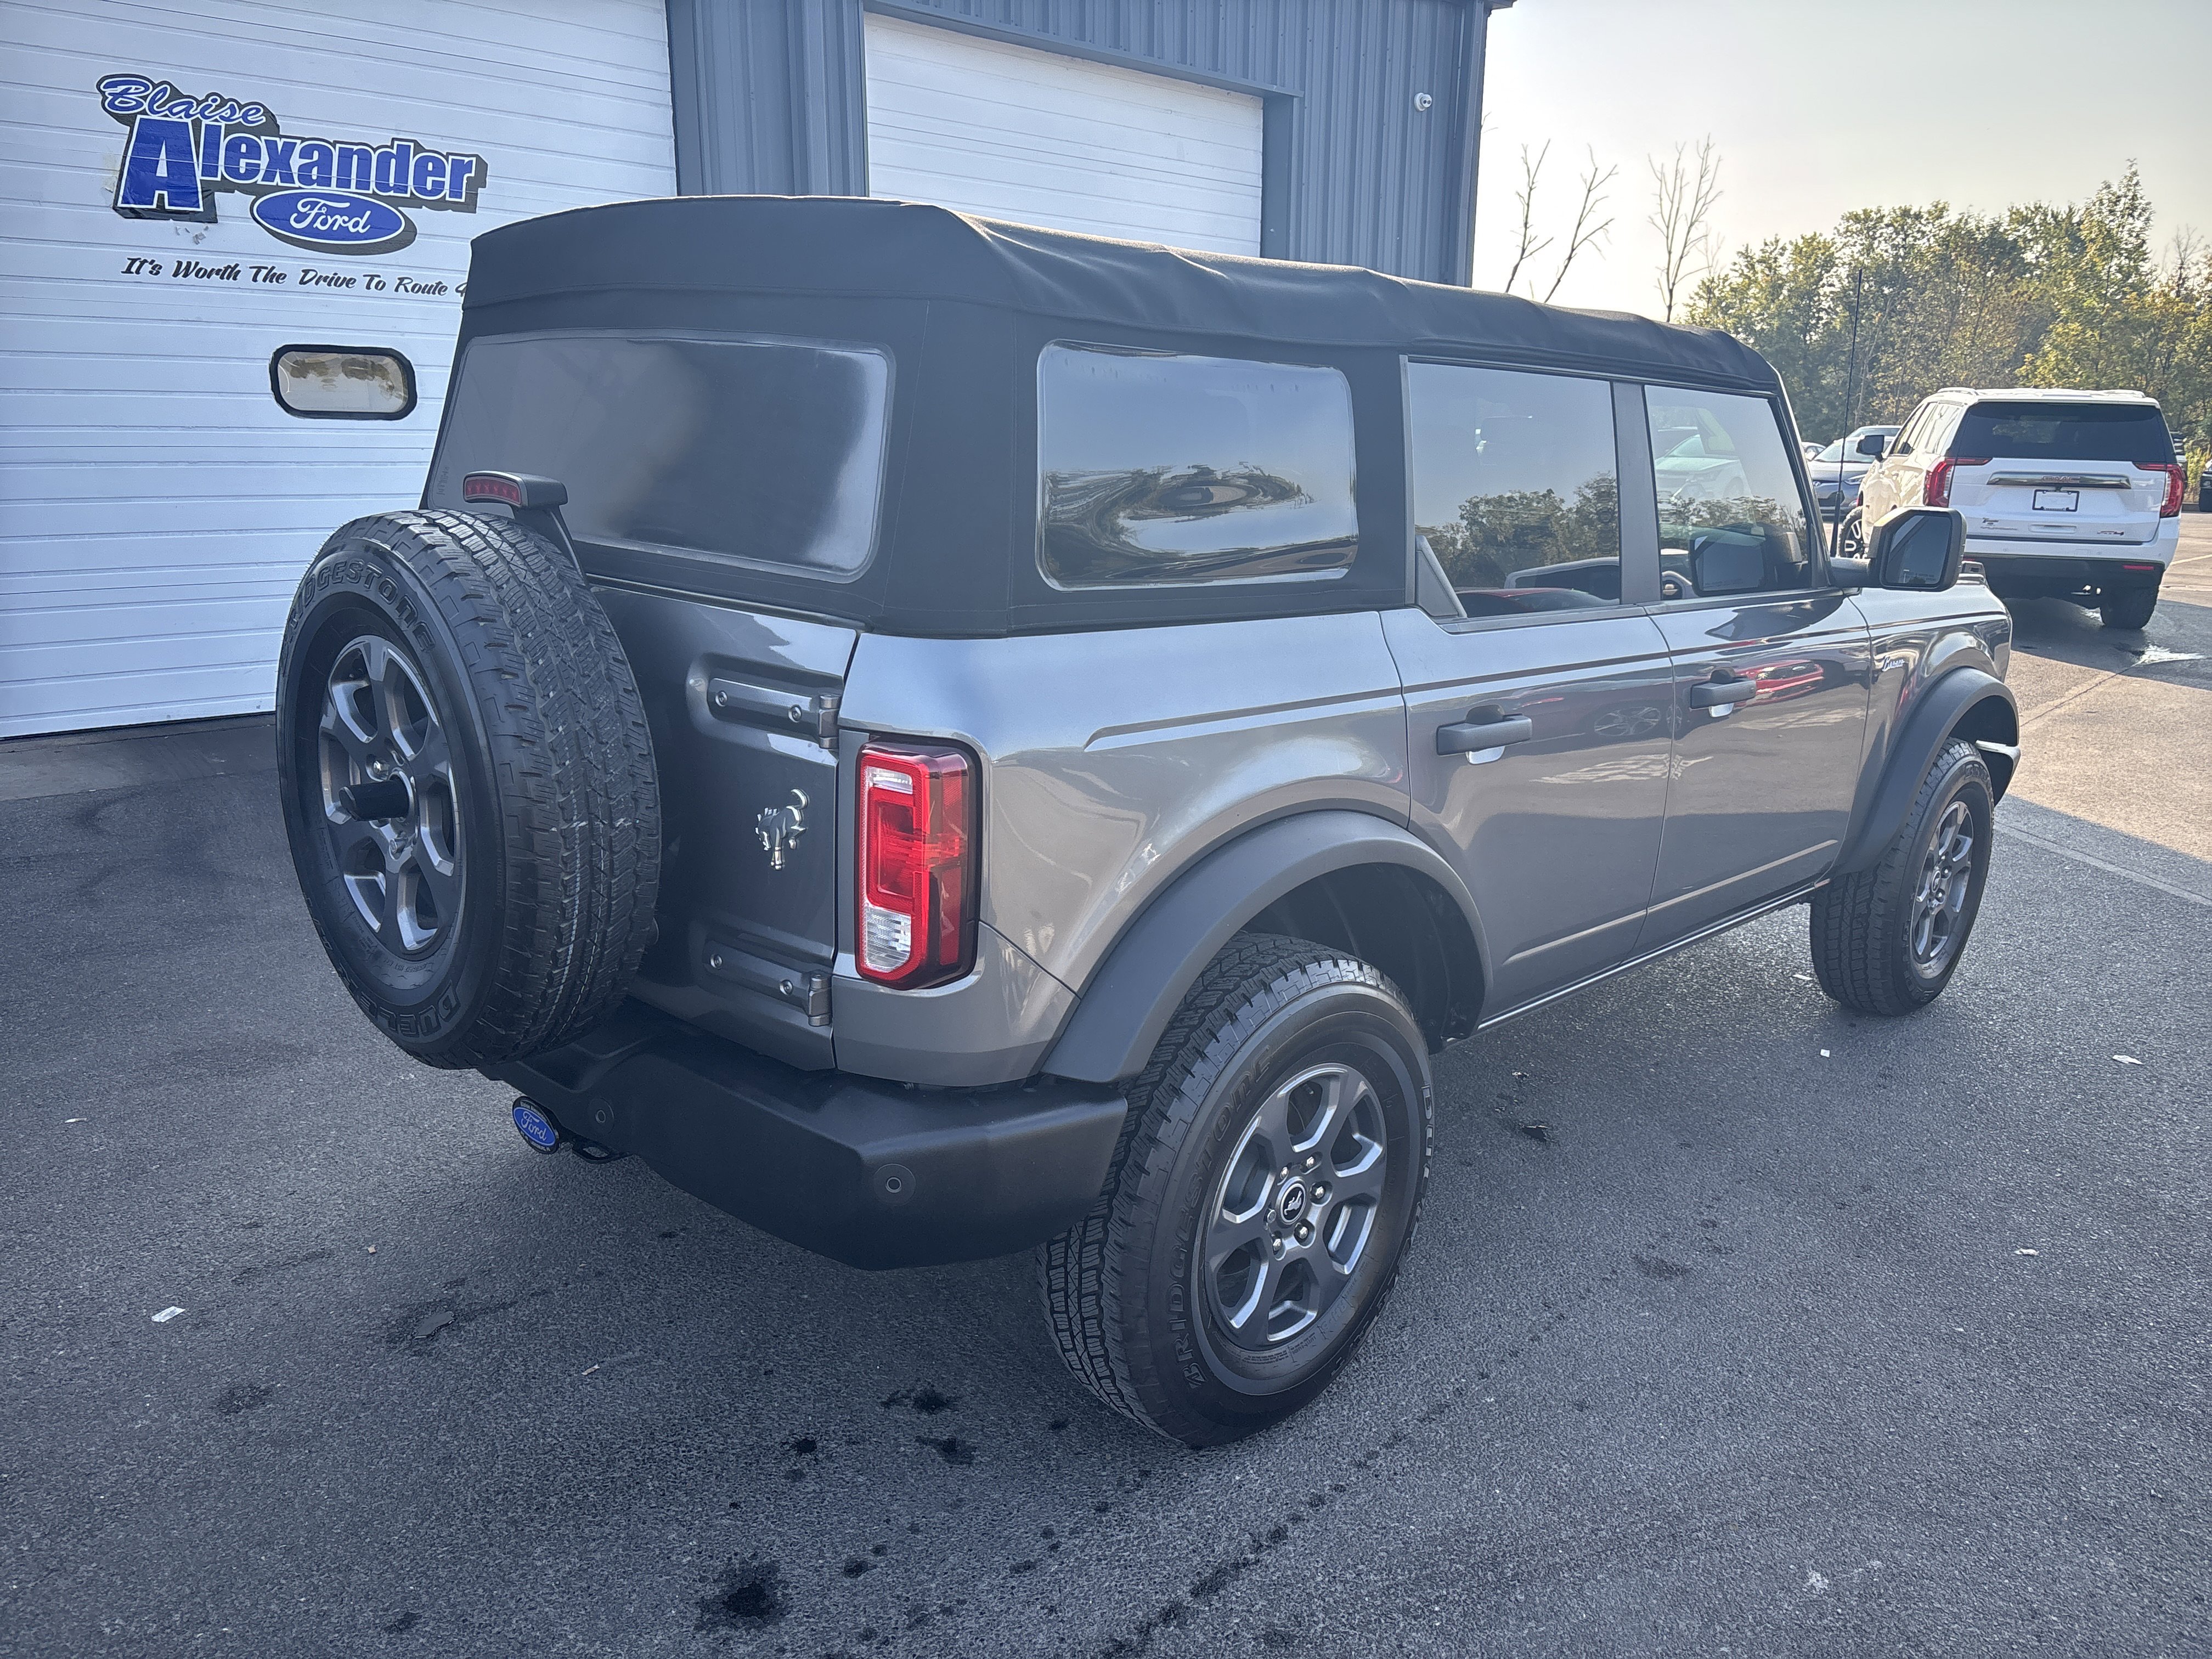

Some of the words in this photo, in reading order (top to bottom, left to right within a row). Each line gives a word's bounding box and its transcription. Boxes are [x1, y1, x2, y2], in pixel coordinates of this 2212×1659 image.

[99, 77, 266, 126] Blaise
[117, 114, 477, 212] Alexander
[290, 197, 370, 234] Ford
[121, 257, 163, 276] It's
[172, 260, 241, 280] Worth
[249, 266, 287, 284] The
[298, 269, 357, 289] Drive
[363, 274, 386, 291] To
[393, 277, 448, 296] Route
[521, 1111, 547, 1141] Ford
[1166, 1045, 1272, 1390] BRIDGESTONE
